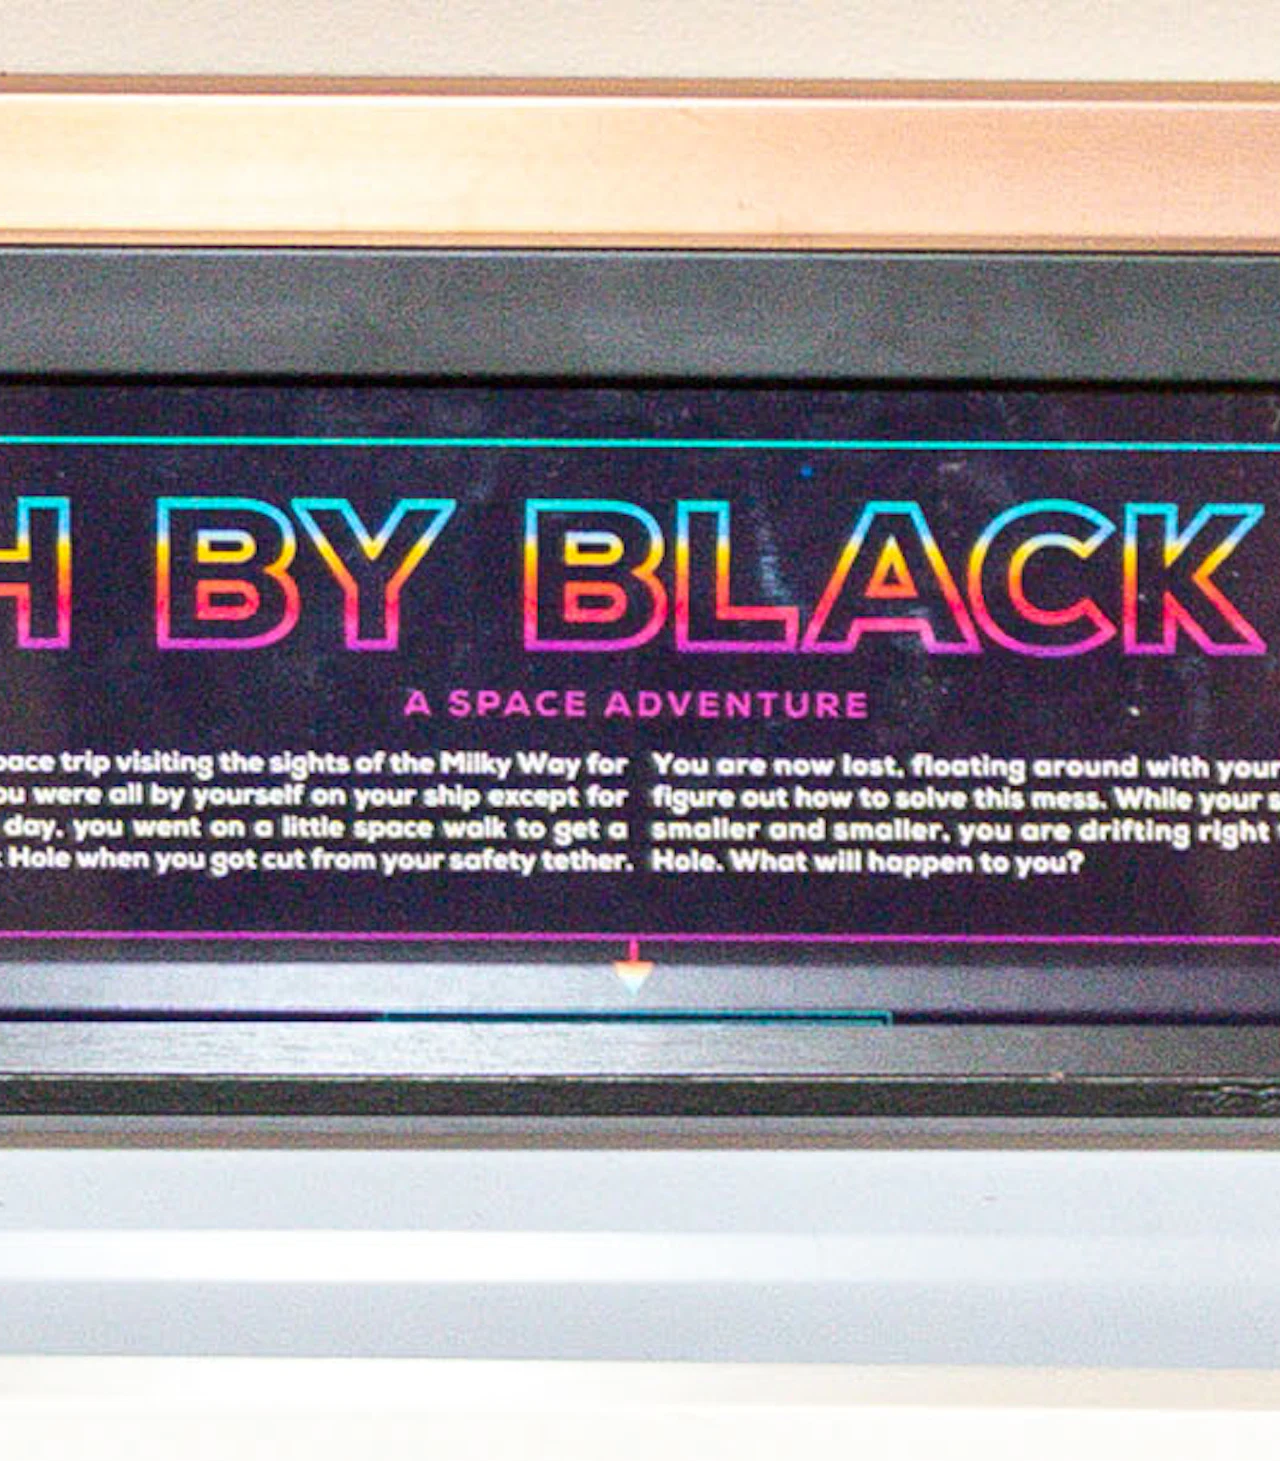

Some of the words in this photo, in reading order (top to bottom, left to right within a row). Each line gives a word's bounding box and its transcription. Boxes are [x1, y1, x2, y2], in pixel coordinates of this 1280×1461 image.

[156, 497, 457, 651] BY
[523, 498, 1267, 657] BLACK
[403, 690, 432, 717] A
[447, 689, 588, 718] SPACE
[604, 690, 869, 719] ADVENTURE
[59, 750, 111, 777] trip
[115, 750, 214, 777] visiting
[218, 751, 265, 774] the
[269, 751, 350, 778] sights
[354, 751, 386, 774] of
[389, 751, 435, 774] the
[440, 752, 512, 779] Milky
[516, 752, 582, 779] Way
[586, 752, 629, 775] for
[651, 753, 709, 776] You
[715, 757, 767, 776] are
[772, 757, 835, 776] now
[911, 754, 1026, 781] floating
[1032, 755, 1138, 778] around
[1145, 755, 1210, 778] with
[32, 786, 103, 805] were
[108, 782, 144, 805] all
[149, 782, 186, 809] by
[192, 783, 305, 810] yourself
[310, 787, 347, 806] on
[353, 787, 418, 810] your
[423, 784, 481, 811] ship
[486, 784, 579, 811] except
[585, 784, 629, 807] for
[651, 785, 735, 812] figure
[741, 785, 788, 808] out
[794, 785, 853, 808] how
[858, 786, 889, 809] to
[895, 786, 967, 809] solve
[973, 786, 1025, 809] this
[1031, 791, 1107, 810] mess.
[1114, 787, 1193, 810] While
[1199, 791, 1263, 814] your
[72, 819, 124, 842] you
[131, 815, 202, 838] went
[208, 819, 246, 838] on
[252, 820, 274, 839] a
[281, 816, 346, 839] little
[352, 820, 435, 843] space
[441, 817, 507, 840] walk
[513, 817, 547, 840] to
[552, 817, 600, 844] get
[606, 821, 629, 840] a
[650, 818, 761, 841] smaller
[767, 818, 826, 841] and
[957, 823, 1012, 846] you
[1018, 824, 1072, 843] are
[1077, 820, 1191, 847] drifting
[1197, 820, 1270, 847] right
[7, 847, 72, 870] Hole
[75, 847, 150, 870] when
[154, 851, 206, 874] you
[210, 848, 257, 875] got
[261, 848, 306, 871] cut
[310, 848, 377, 871] from
[380, 852, 446, 875] your
[449, 849, 537, 876] safety
[540, 849, 634, 872] tether.
[651, 850, 724, 873] Hole.
[728, 850, 808, 873] What
[813, 851, 862, 874] will
[867, 851, 974, 878] happen
[978, 851, 1010, 874] to
[1014, 852, 1085, 879] you?
